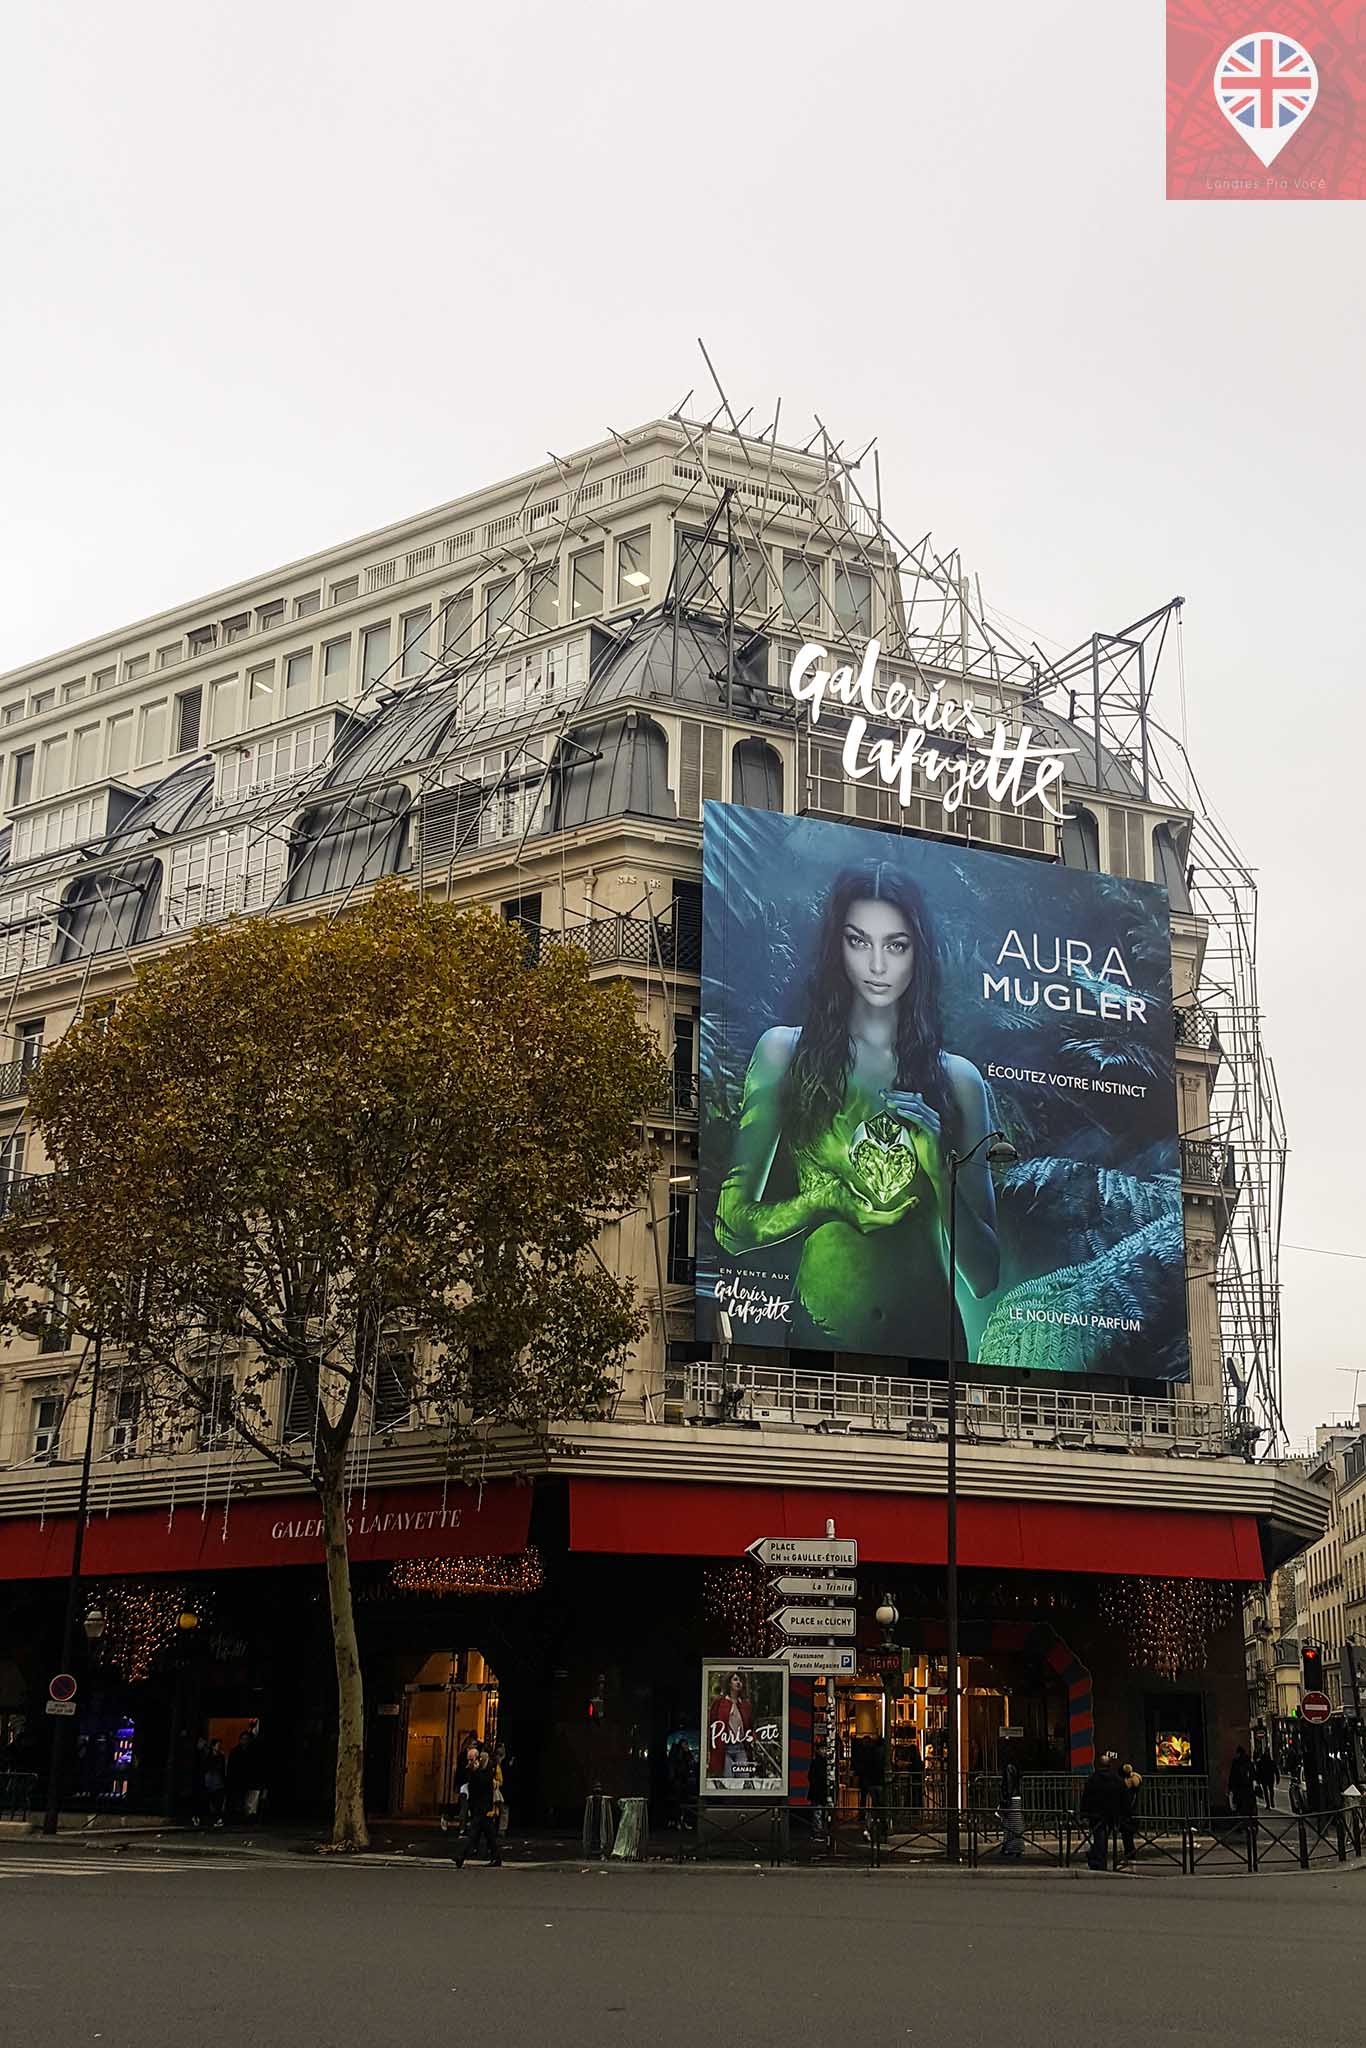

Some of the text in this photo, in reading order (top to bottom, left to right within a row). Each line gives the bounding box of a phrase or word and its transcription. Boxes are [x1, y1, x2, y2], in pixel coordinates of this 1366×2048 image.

[789, 638, 985, 739] Galeries
[842, 716, 1081, 819] Lafayette
[996, 930, 1132, 987] AURA
[983, 973, 1147, 1024] MUGLER
[987, 1062, 1147, 1098] ÉCOUTEZ VOTRE INSTINCT
[714, 1276, 768, 1303] Galeries
[736, 1269, 767, 1278] VENTE
[771, 1272, 790, 1280] AUX
[1009, 1308, 1141, 1332] LE NOUVEAU PARFUM
[271, 1509, 463, 1540] GALERS LAFAYETTE
[770, 1543, 796, 1551] PLACE
[790, 1616, 815, 1625] PLACE
[825, 1617, 852, 1626] CLICHY
[710, 1721, 780, 1750] Paris etc
